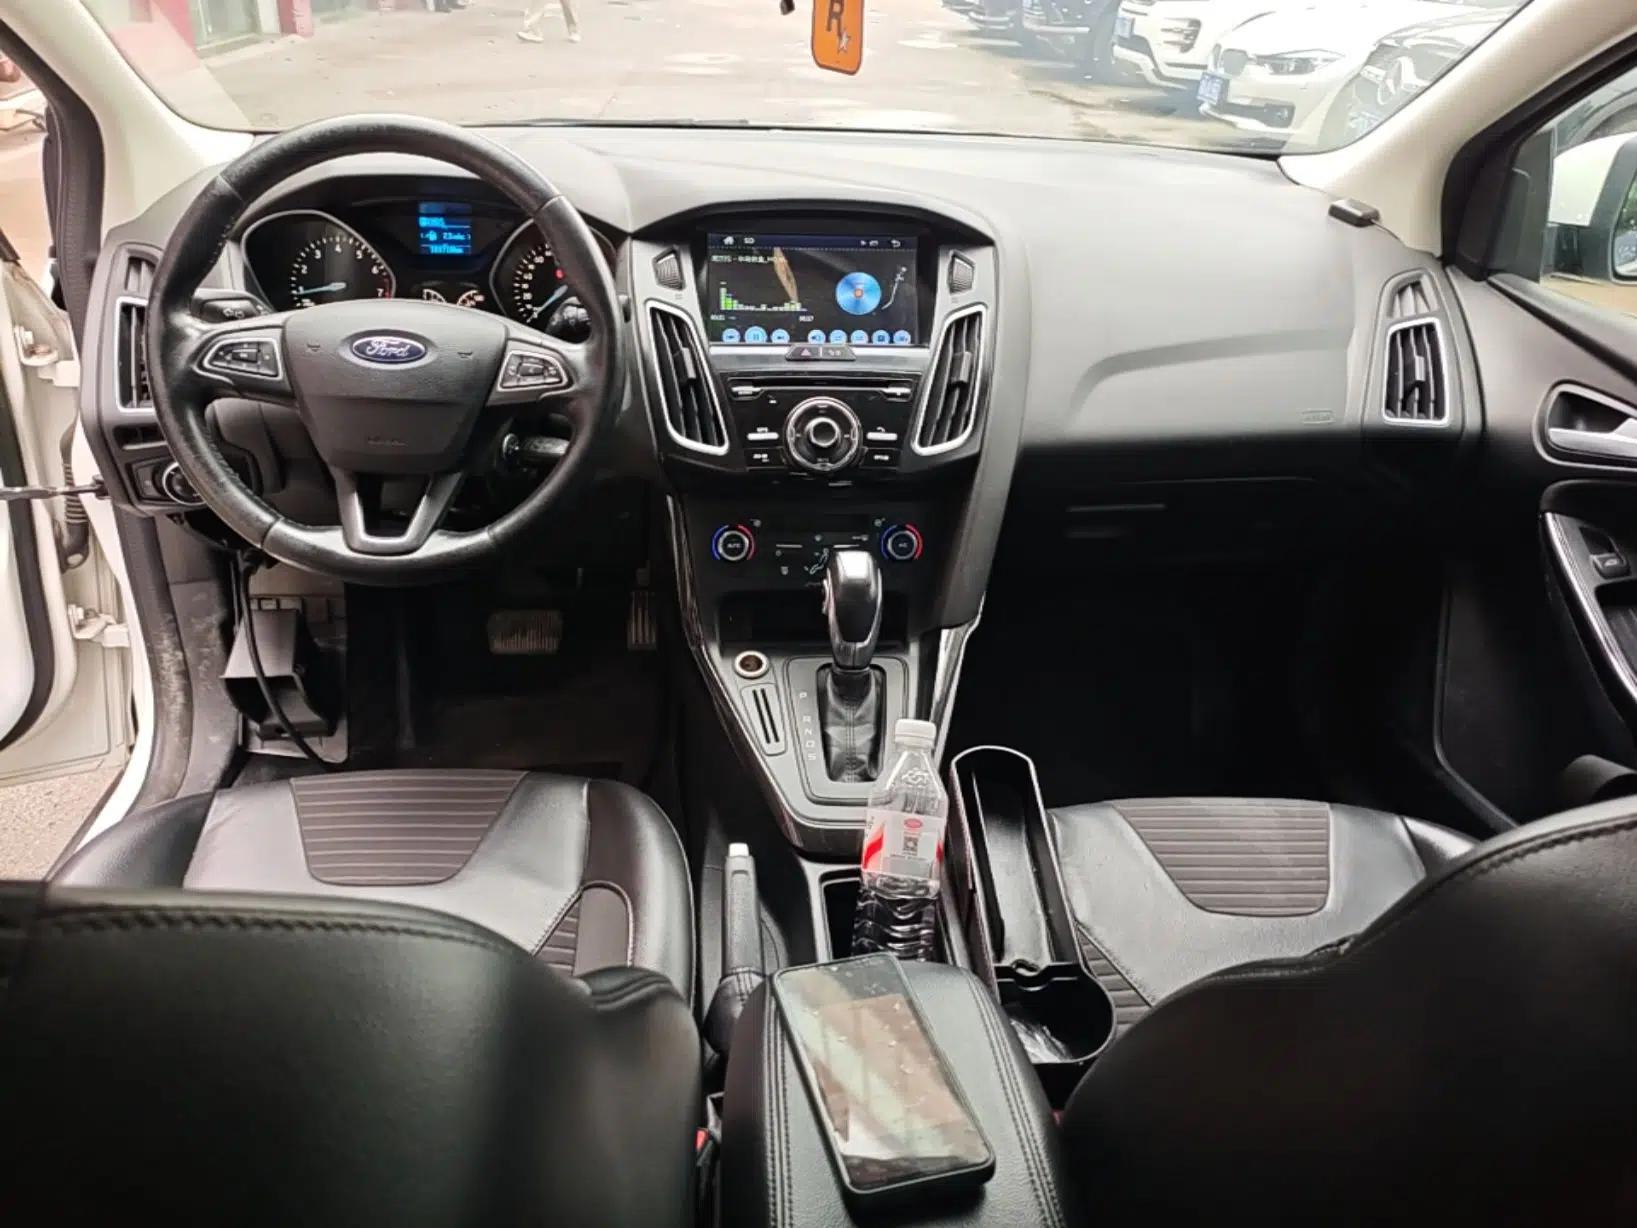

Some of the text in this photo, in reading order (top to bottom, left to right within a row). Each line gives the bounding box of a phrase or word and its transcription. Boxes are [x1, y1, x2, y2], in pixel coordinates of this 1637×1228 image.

[335, 244, 342, 253] 4
[315, 249, 322, 259] 3
[356, 250, 363, 259] 5
[301, 264, 308, 274] 2
[371, 265, 379, 274] 6
[376, 288, 384, 297] 7
[366, 339, 411, 357] Ford
[799, 691, 808, 699] P
[802, 715, 812, 724] R
[804, 728, 813, 736] N
[807, 753, 817, 761] S
